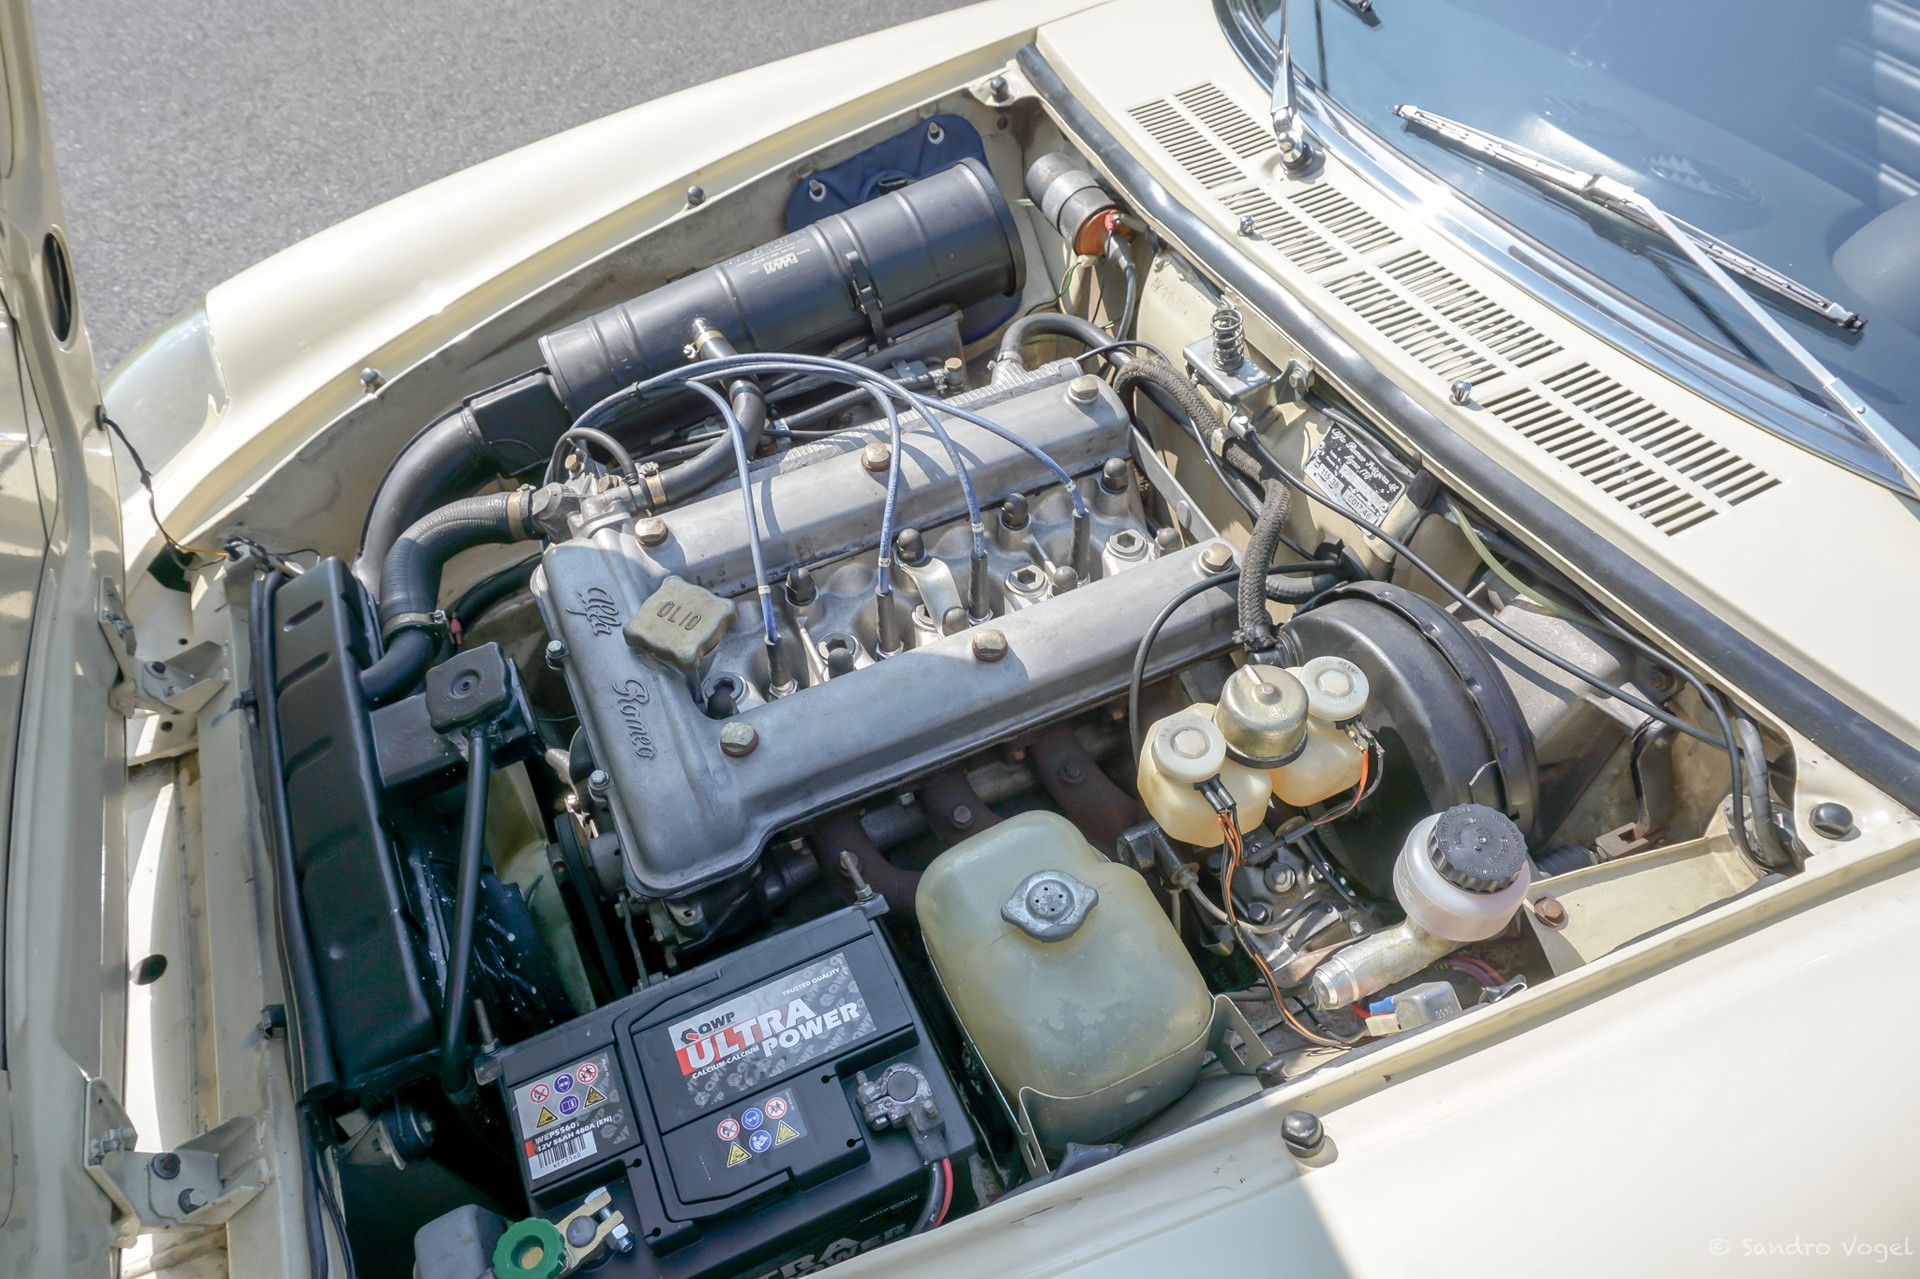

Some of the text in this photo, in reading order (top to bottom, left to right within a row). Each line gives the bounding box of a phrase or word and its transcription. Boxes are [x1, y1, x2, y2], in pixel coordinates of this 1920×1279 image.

[880, 522, 891, 551] LUCAS
[566, 587, 622, 637] Alfa
[656, 600, 702, 631] OLIO
[612, 679, 656, 761] Romeo
[782, 967, 840, 997] TRUSTED QUALITY
[685, 997, 817, 1069] ULTRA
[697, 1011, 736, 1035] QWP
[761, 1002, 861, 1057] POWER
[692, 1045, 760, 1079] CALCIUM-CALCIUM
[534, 1122, 576, 1144] WEP5560
[537, 1142, 552, 1152] 12V
